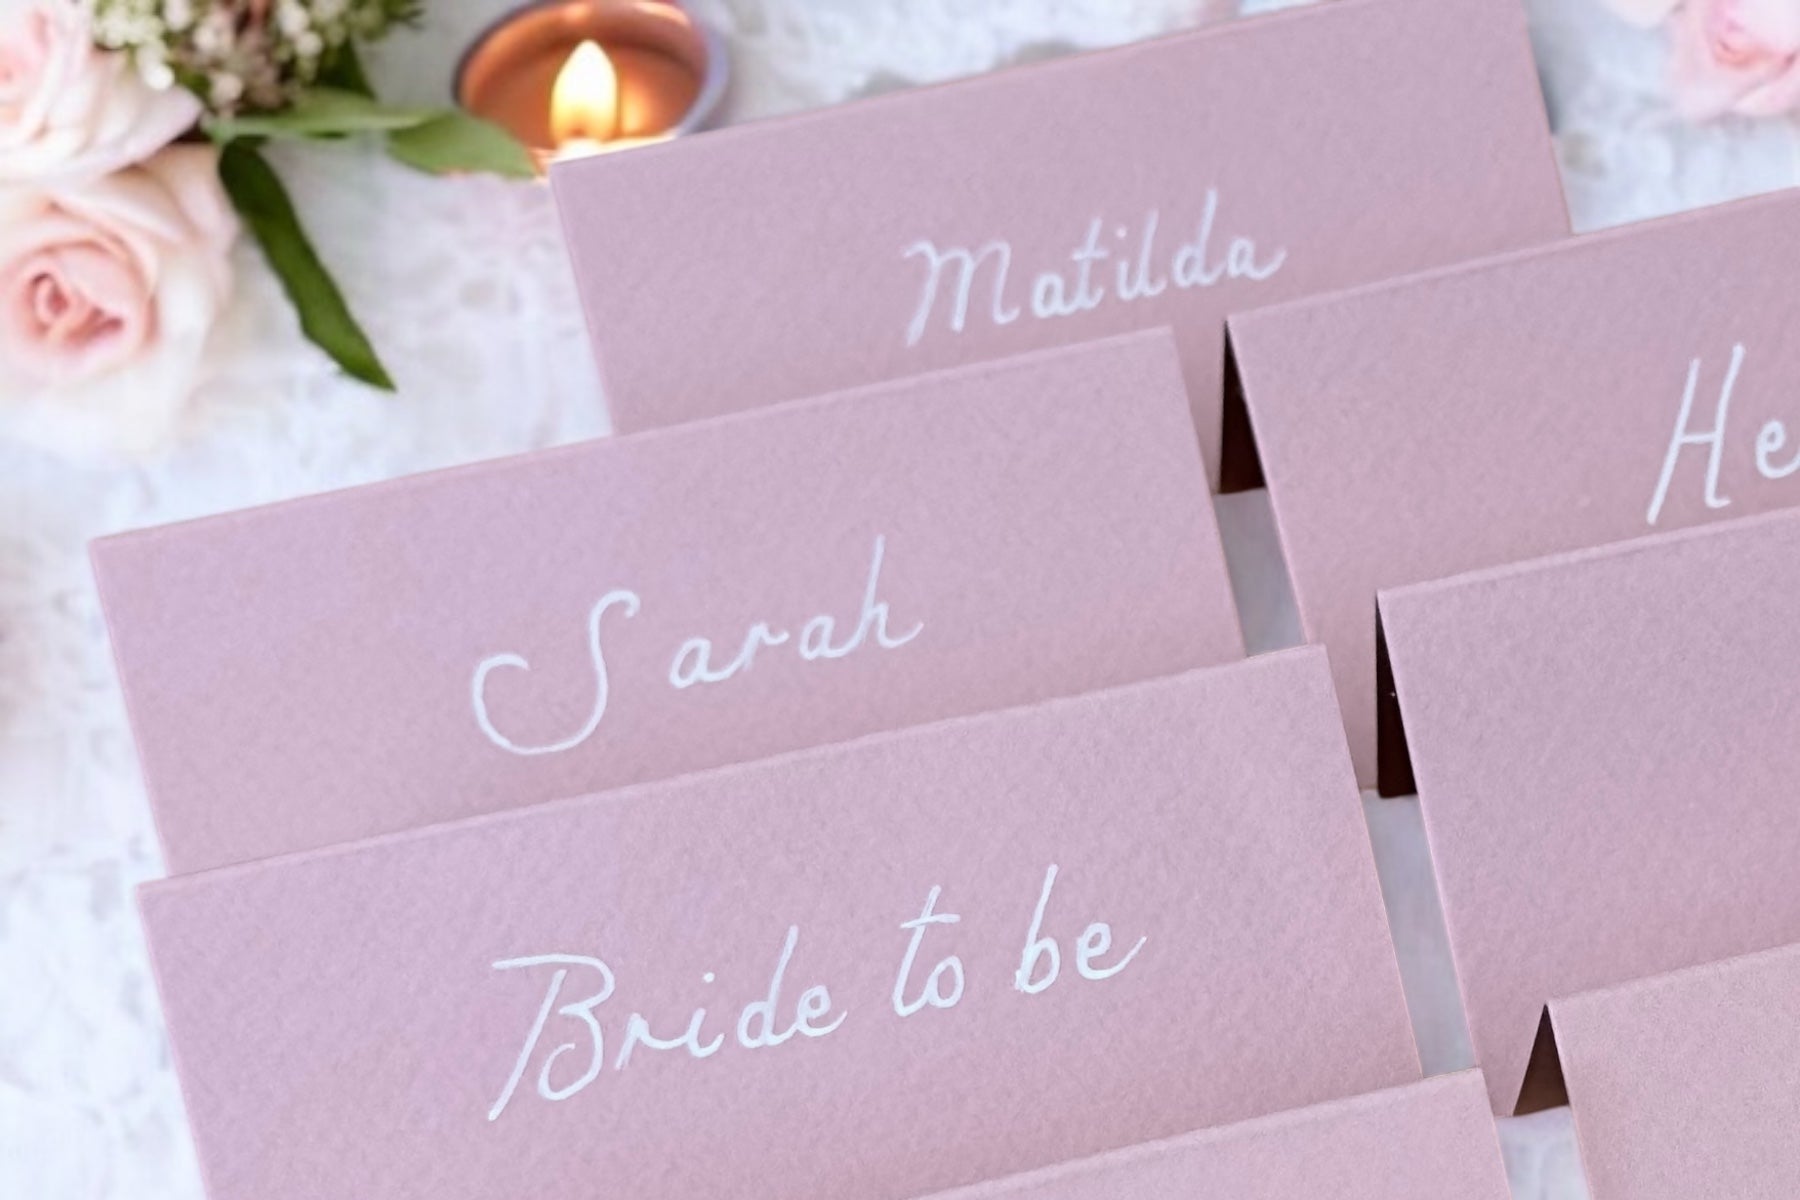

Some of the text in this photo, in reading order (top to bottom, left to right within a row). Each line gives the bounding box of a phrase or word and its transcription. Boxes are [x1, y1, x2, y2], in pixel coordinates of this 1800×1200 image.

[904, 188, 1286, 345] Matilda
[473, 536, 924, 755] Sarah
[489, 864, 1148, 1122] Bride to be
